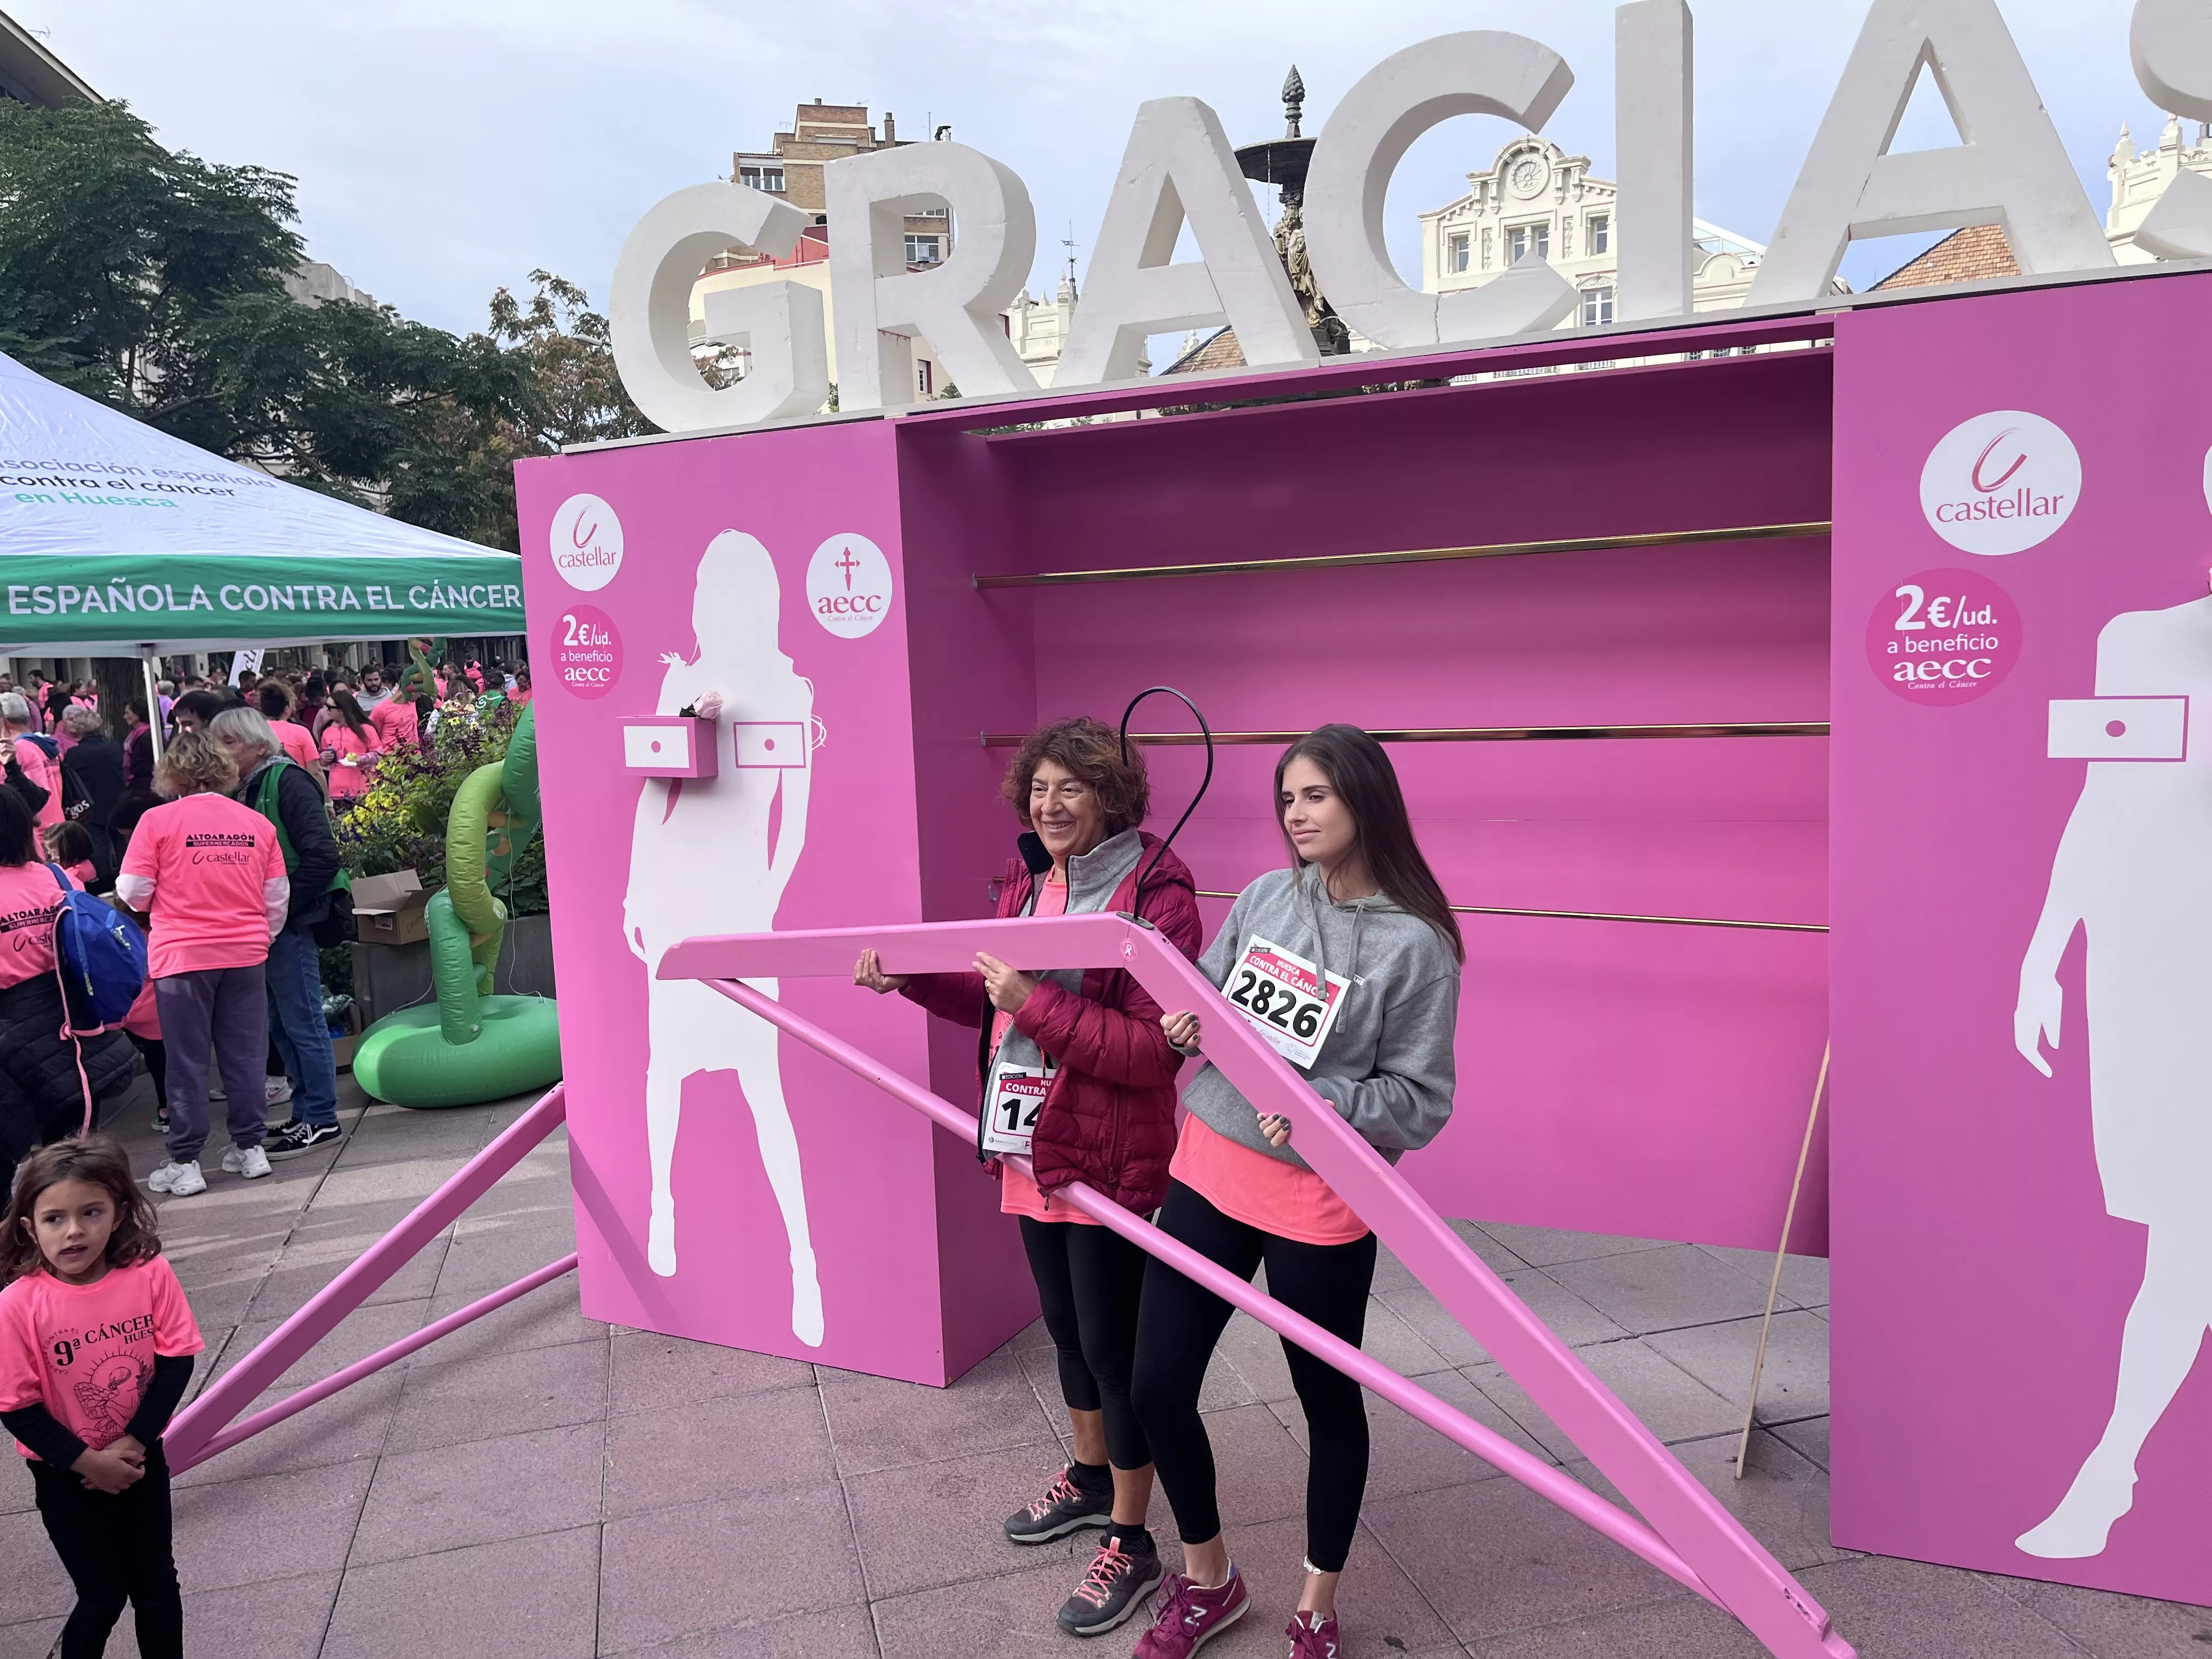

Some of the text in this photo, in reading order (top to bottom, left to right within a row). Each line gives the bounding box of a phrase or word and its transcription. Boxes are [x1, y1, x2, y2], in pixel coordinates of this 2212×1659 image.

[0, 459, 277, 488] sociación española
[0, 475, 235, 496] contra el cáncer
[14, 492, 179, 508] en Huesca
[1936, 488, 2064, 523] castellar
[558, 546, 617, 568] castellar
[8, 577, 522, 614] ESPAÑOLA CONTRA EL CÁNCER
[818, 595, 881, 613] aecc
[1895, 585, 1997, 630] 2€/ud.
[562, 614, 612, 646] 2€/ud.
[1887, 633, 1998, 654] a beneficio
[560, 650, 613, 662] a beneficio
[564, 667, 611, 681] aecc
[1893, 658, 1991, 681] aecc
[207, 851, 250, 862] castellar
[1250, 956, 1278, 977] CONTRA
[1279, 971, 1289, 982] EL
[1277, 960, 1300, 976] HUESCA
[1231, 969, 1323, 1038] 2826
[1005, 1083, 1046, 1096] CONTRA
[84, 1314, 154, 1344] CÁNCER
[125, 1328, 157, 1345] HUES
[54, 1337, 81, 1367] 9ª
